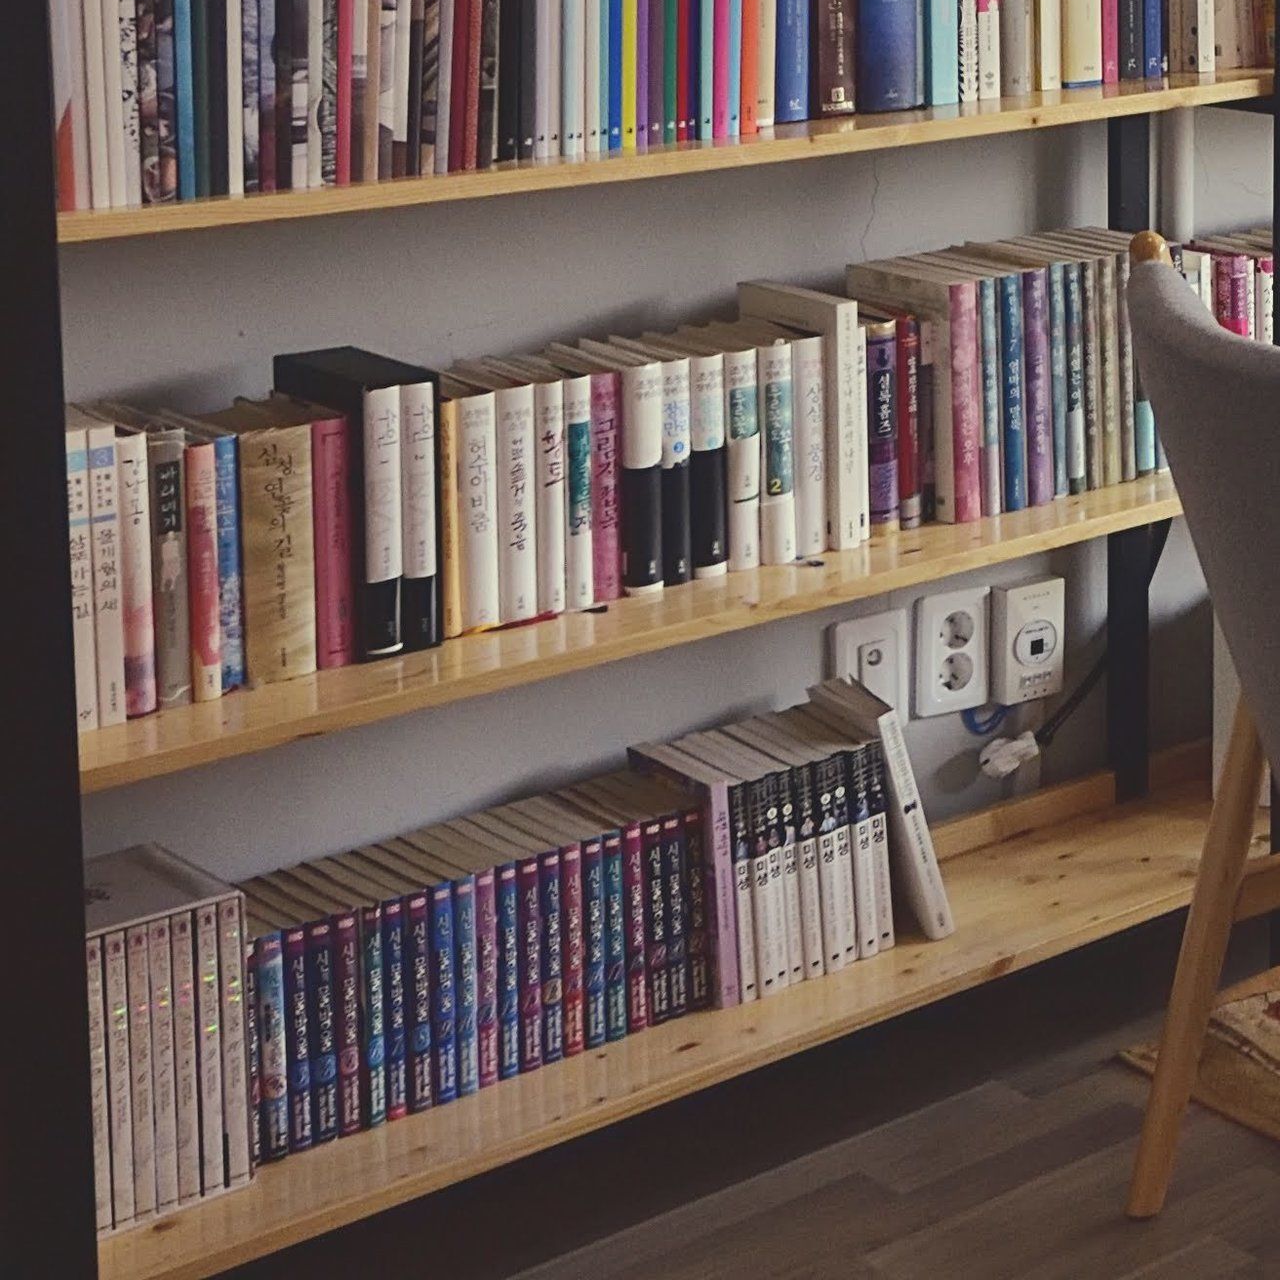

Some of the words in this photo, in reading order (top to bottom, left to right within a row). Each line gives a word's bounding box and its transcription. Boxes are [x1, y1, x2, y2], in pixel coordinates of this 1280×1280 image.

[375, 410, 398, 447] 수인
[411, 403, 433, 444] 수인
[808, 443, 823, 482] 풍경
[123, 458, 146, 526] 강남몽
[159, 467, 178, 527] 바리데기
[468, 434, 491, 534] 허수아비춤
[771, 479, 782, 492] 2
[273, 535, 292, 558] 길
[73, 603, 90, 619] 길
